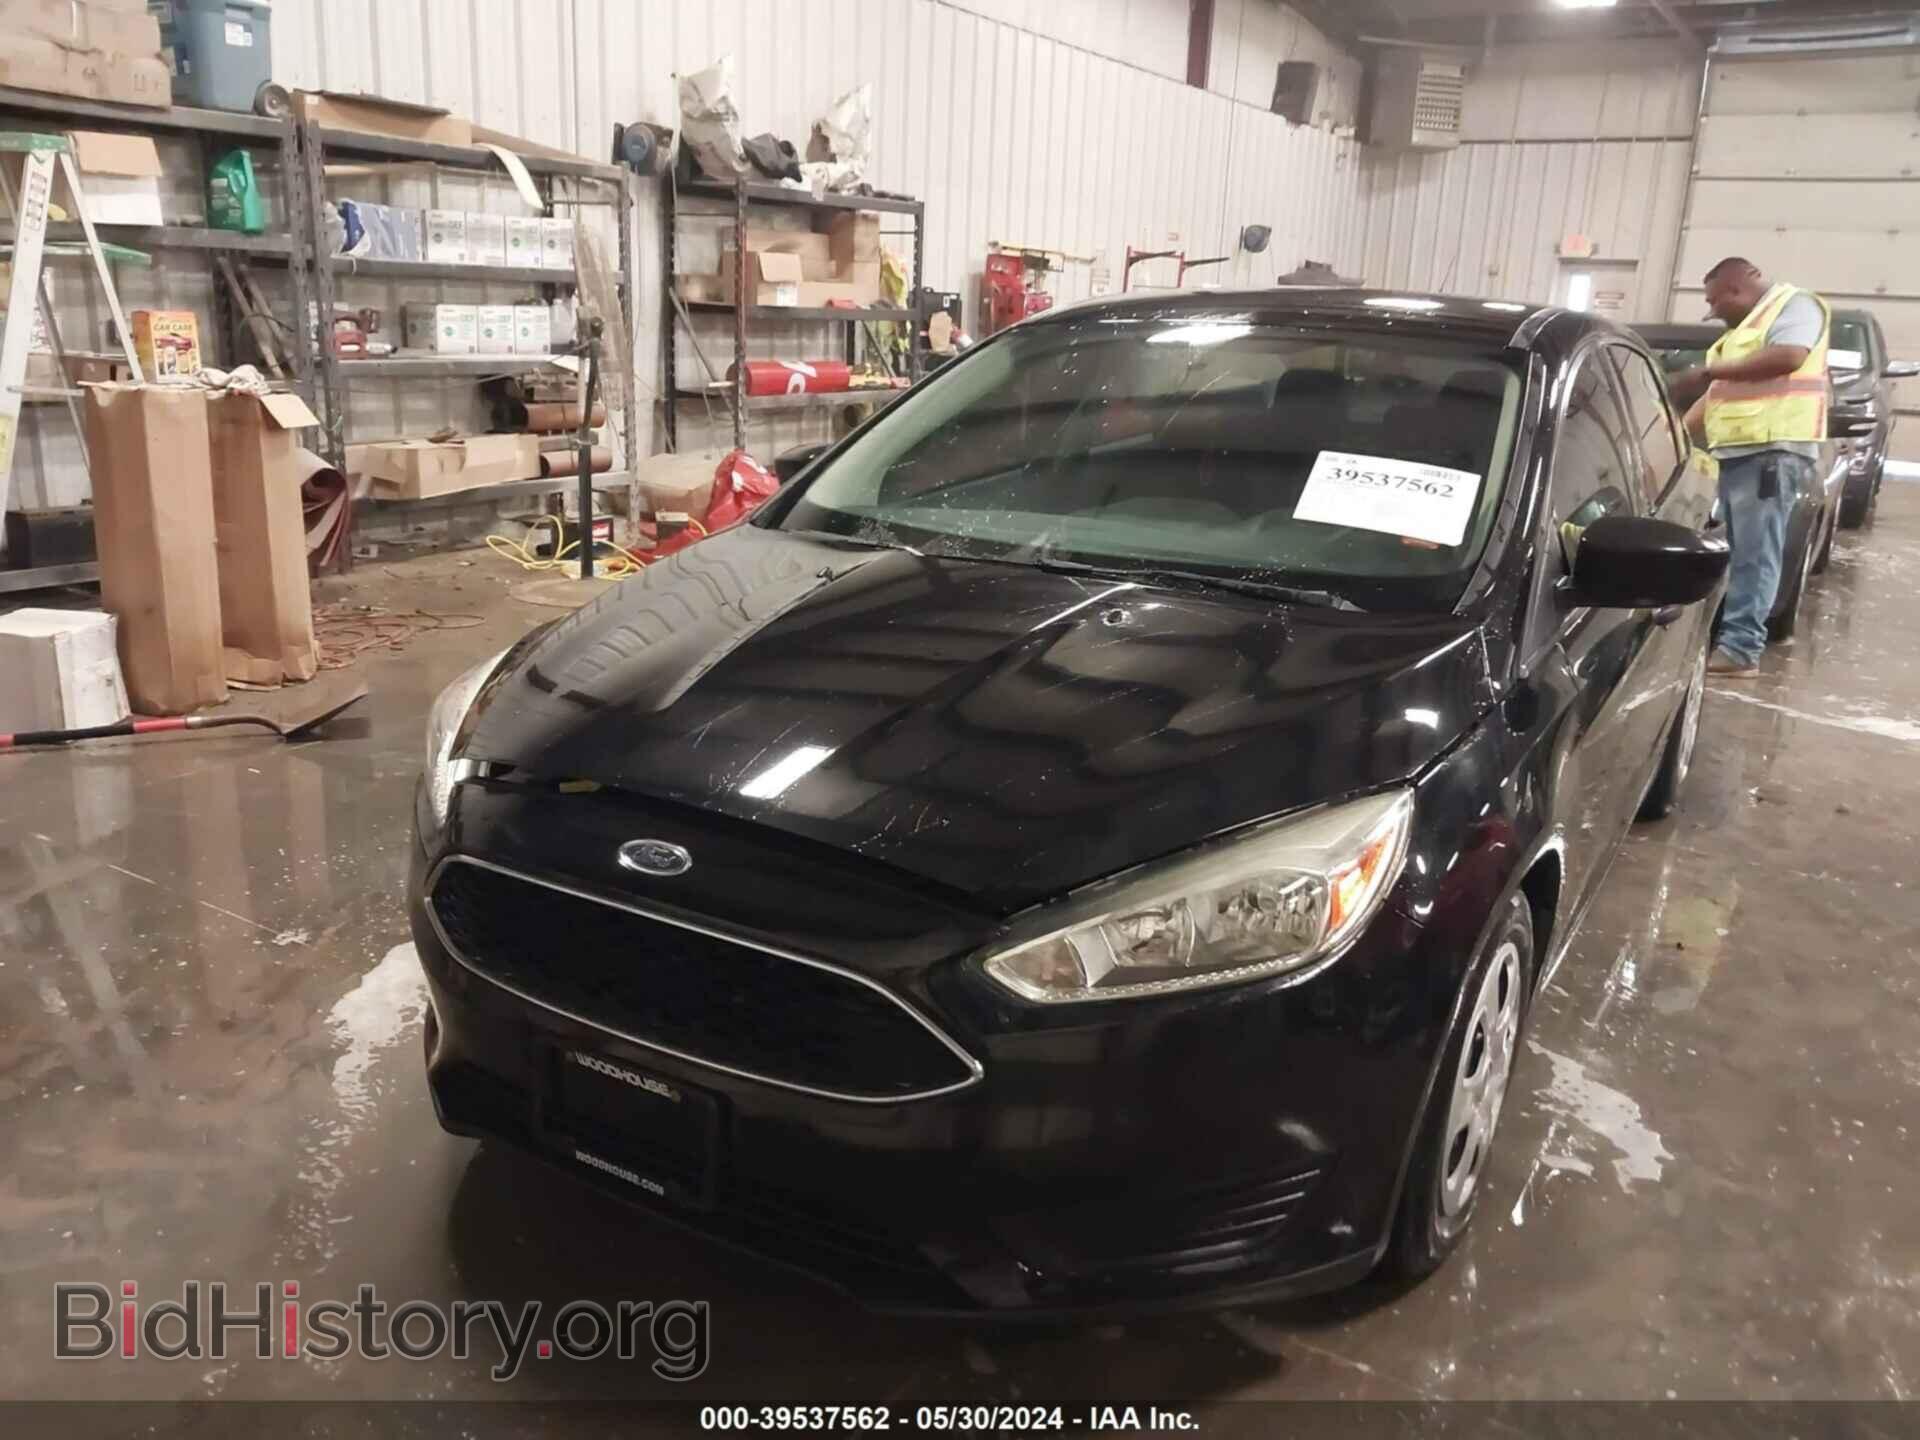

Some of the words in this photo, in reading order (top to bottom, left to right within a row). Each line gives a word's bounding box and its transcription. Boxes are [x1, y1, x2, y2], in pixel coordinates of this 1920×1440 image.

[1327, 466, 1455, 498] 39537562
[575, 1051, 671, 1098] WOODHOUSE
[575, 1150, 665, 1196] WOODHOUSE.COM
